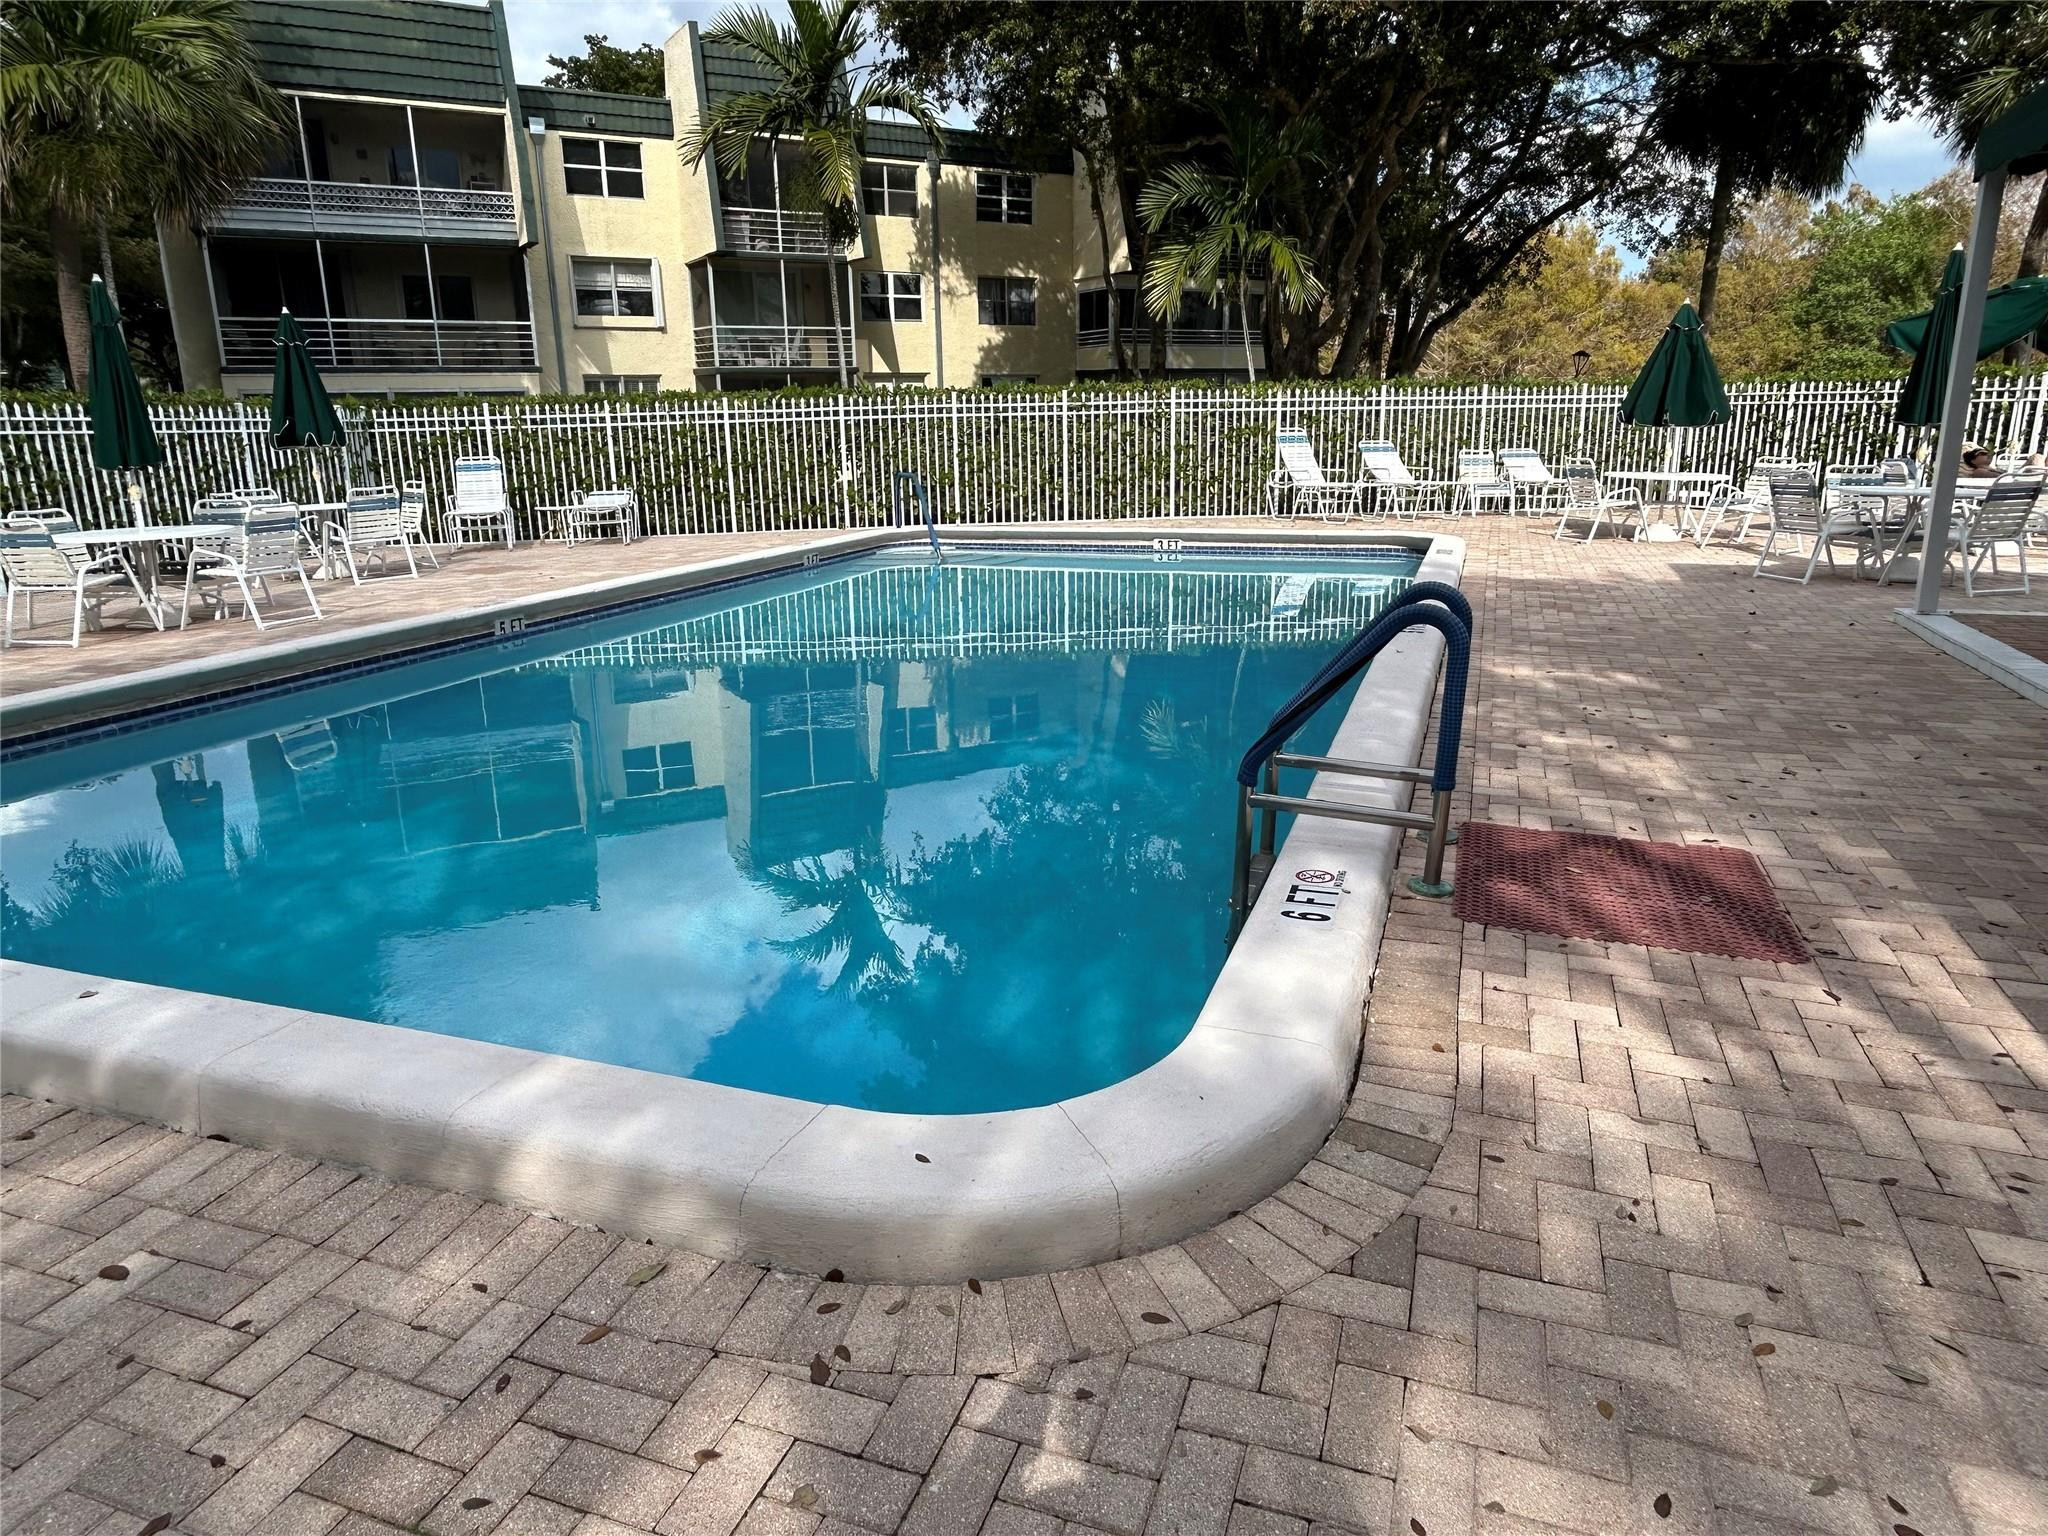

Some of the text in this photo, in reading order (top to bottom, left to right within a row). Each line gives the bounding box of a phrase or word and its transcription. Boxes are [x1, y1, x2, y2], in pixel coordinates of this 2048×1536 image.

[1158, 540, 1180, 550] 3 FT
[511, 617, 524, 632] FT
[1280, 884, 1340, 922] 6 FT
